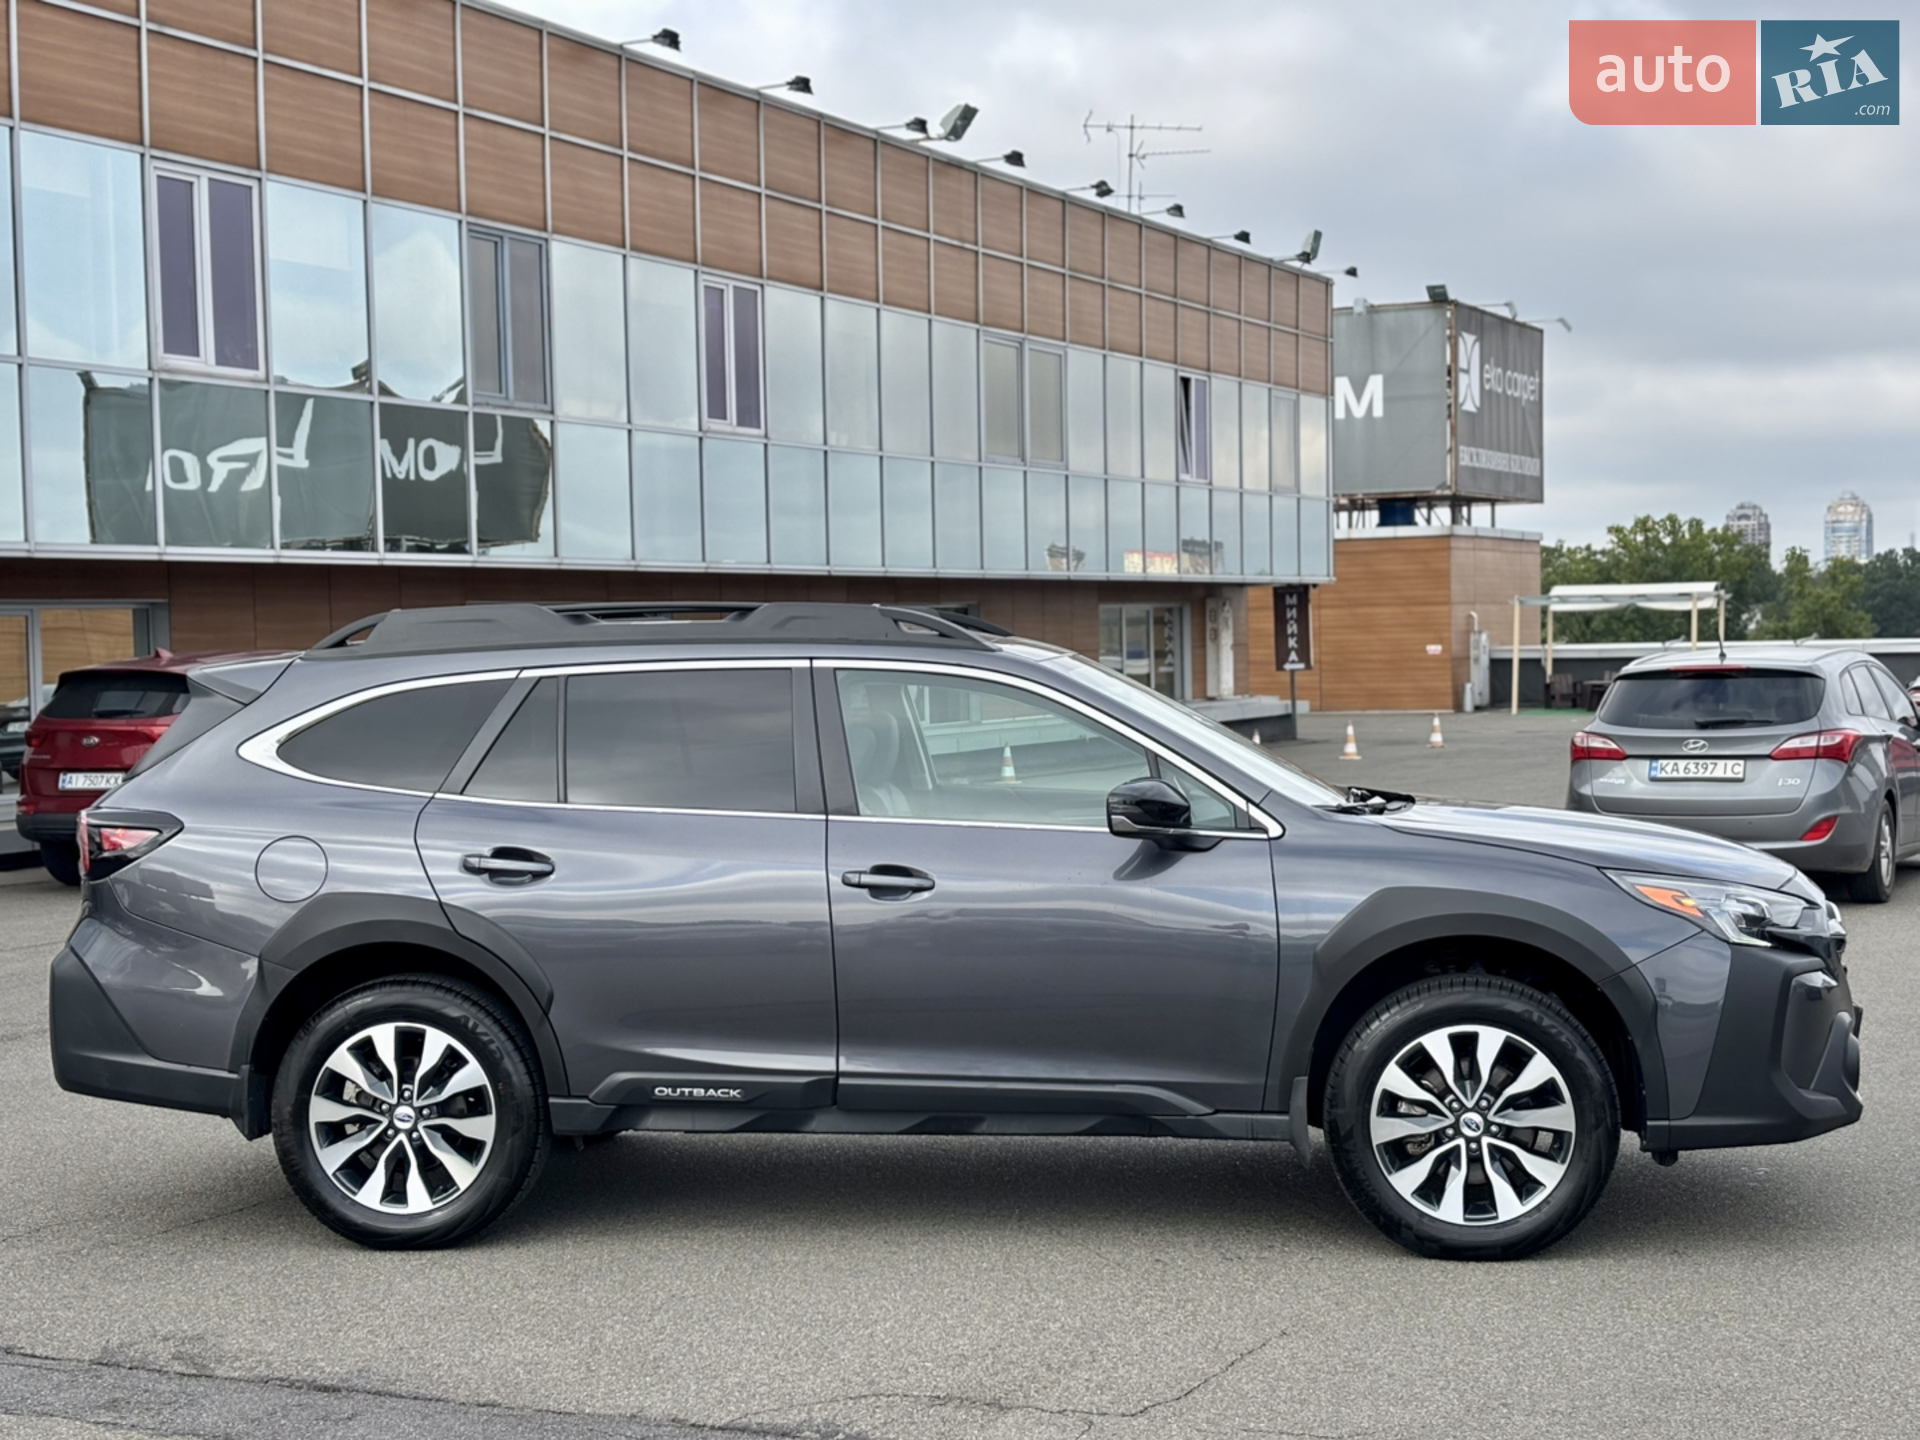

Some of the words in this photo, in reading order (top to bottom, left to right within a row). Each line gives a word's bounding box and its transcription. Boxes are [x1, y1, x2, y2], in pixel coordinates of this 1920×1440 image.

[1483, 357, 1503, 394] eko
[1505, 370, 1540, 407] carpet
[1285, 593, 1299, 662] МИЙКА
[1659, 761, 1680, 775] KA
[1683, 761, 1718, 775] 6397
[67, 776, 78, 786] AI
[82, 775, 104, 786] 7507
[105, 776, 120, 786] KX
[654, 1086, 742, 1098] OUTBACK
